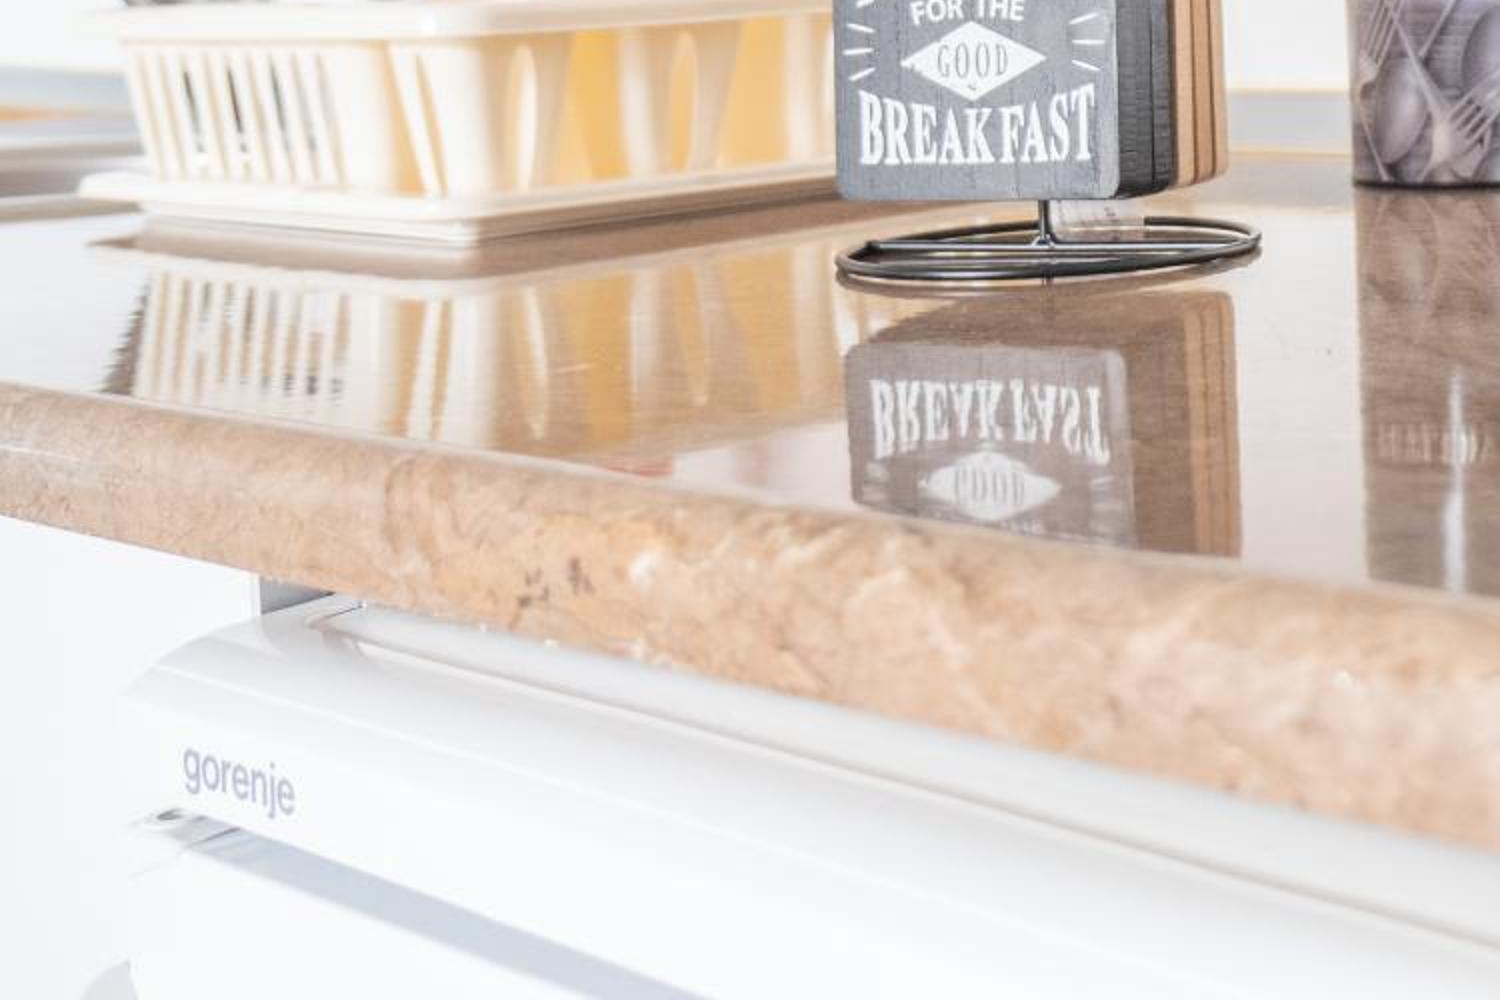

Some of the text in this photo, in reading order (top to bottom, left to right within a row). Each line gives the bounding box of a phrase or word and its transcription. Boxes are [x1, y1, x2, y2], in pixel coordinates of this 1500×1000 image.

[937, 42, 1008, 79] GOOD
[858, 83, 1095, 165] BREAKFAST
[184, 748, 295, 819] gorenje
